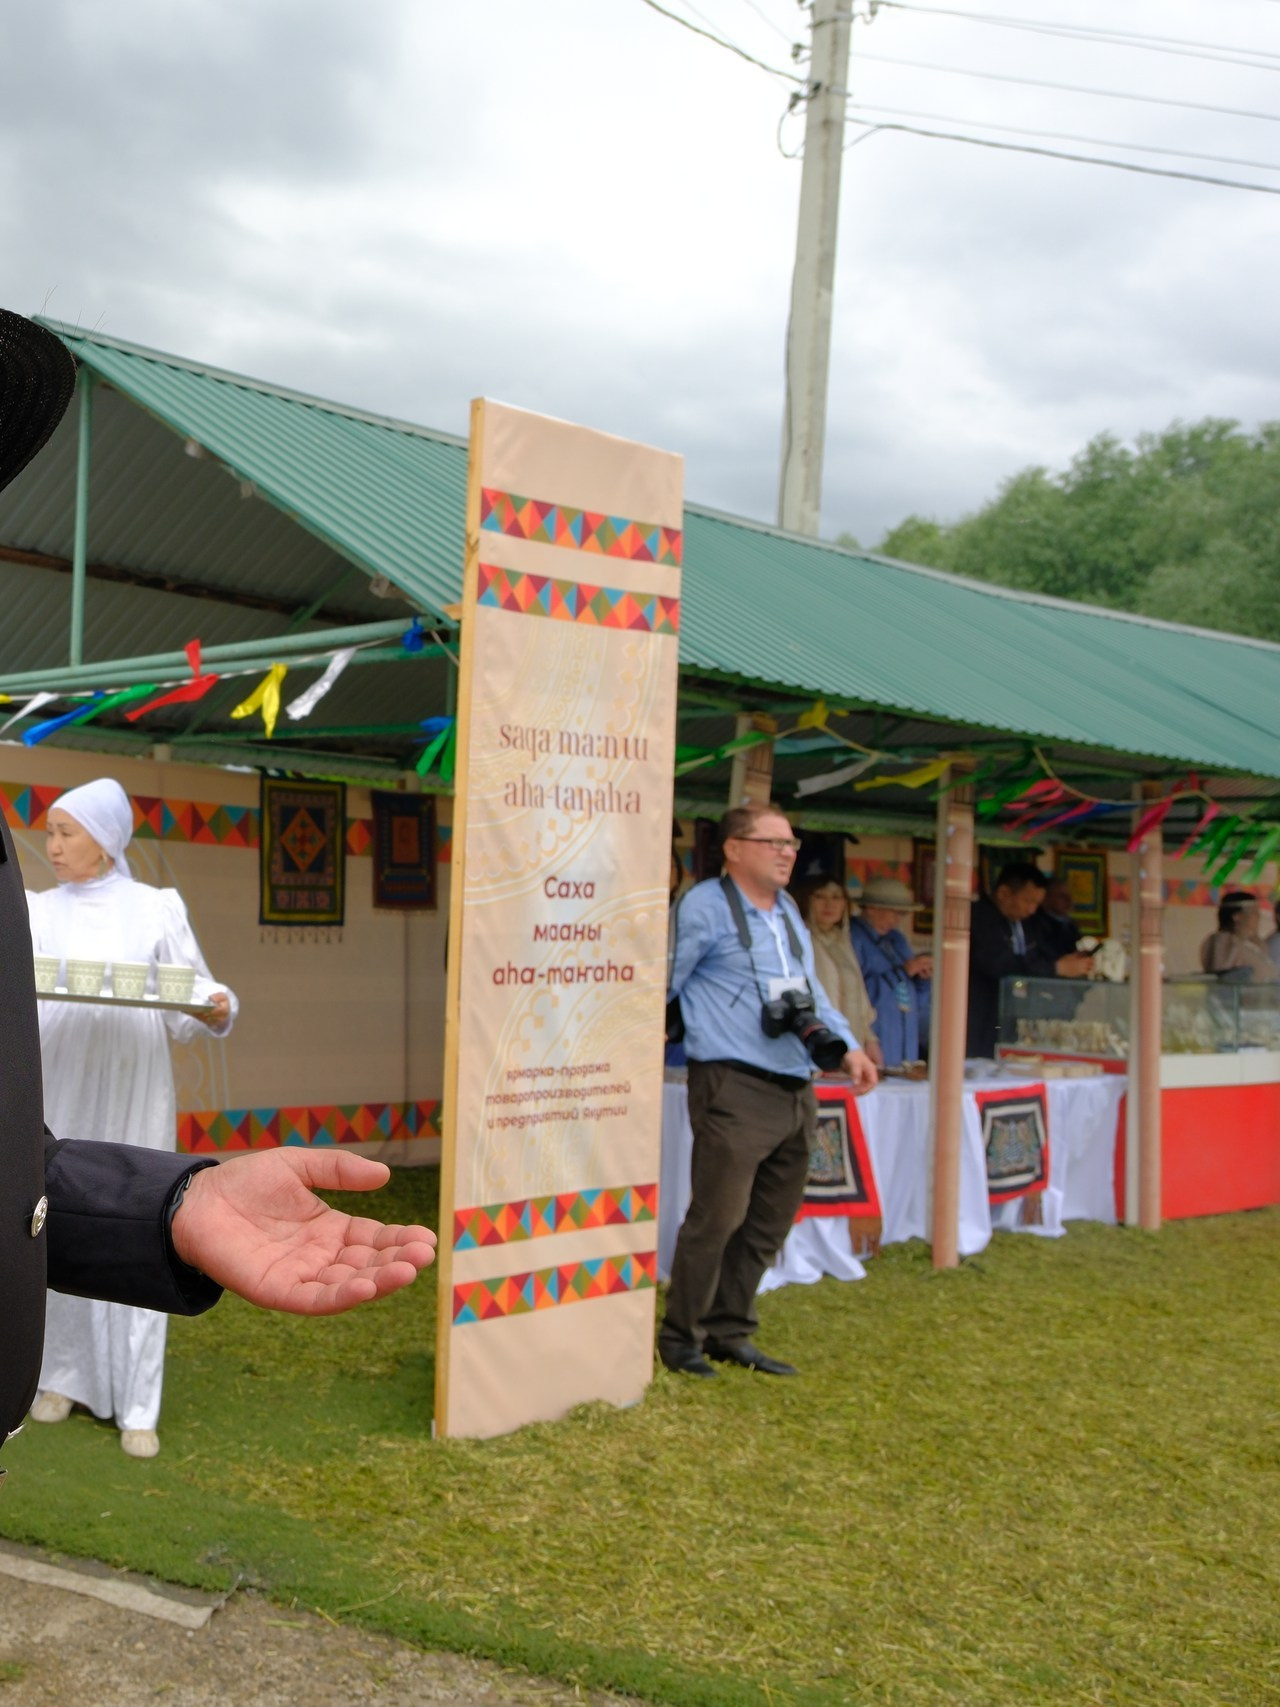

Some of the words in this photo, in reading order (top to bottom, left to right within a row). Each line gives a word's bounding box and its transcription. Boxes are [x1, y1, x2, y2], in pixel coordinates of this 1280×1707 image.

[499, 723, 551, 762] saqa
[544, 876, 596, 899] Саха
[533, 924, 602, 942] мааны
[507, 1062, 611, 1082] ярмарка-продажа
[485, 1081, 631, 1106] товаропроизводителей
[487, 1118, 495, 1129] и
[497, 1108, 579, 1130] предприятий
[583, 1105, 628, 1121] Якутии
